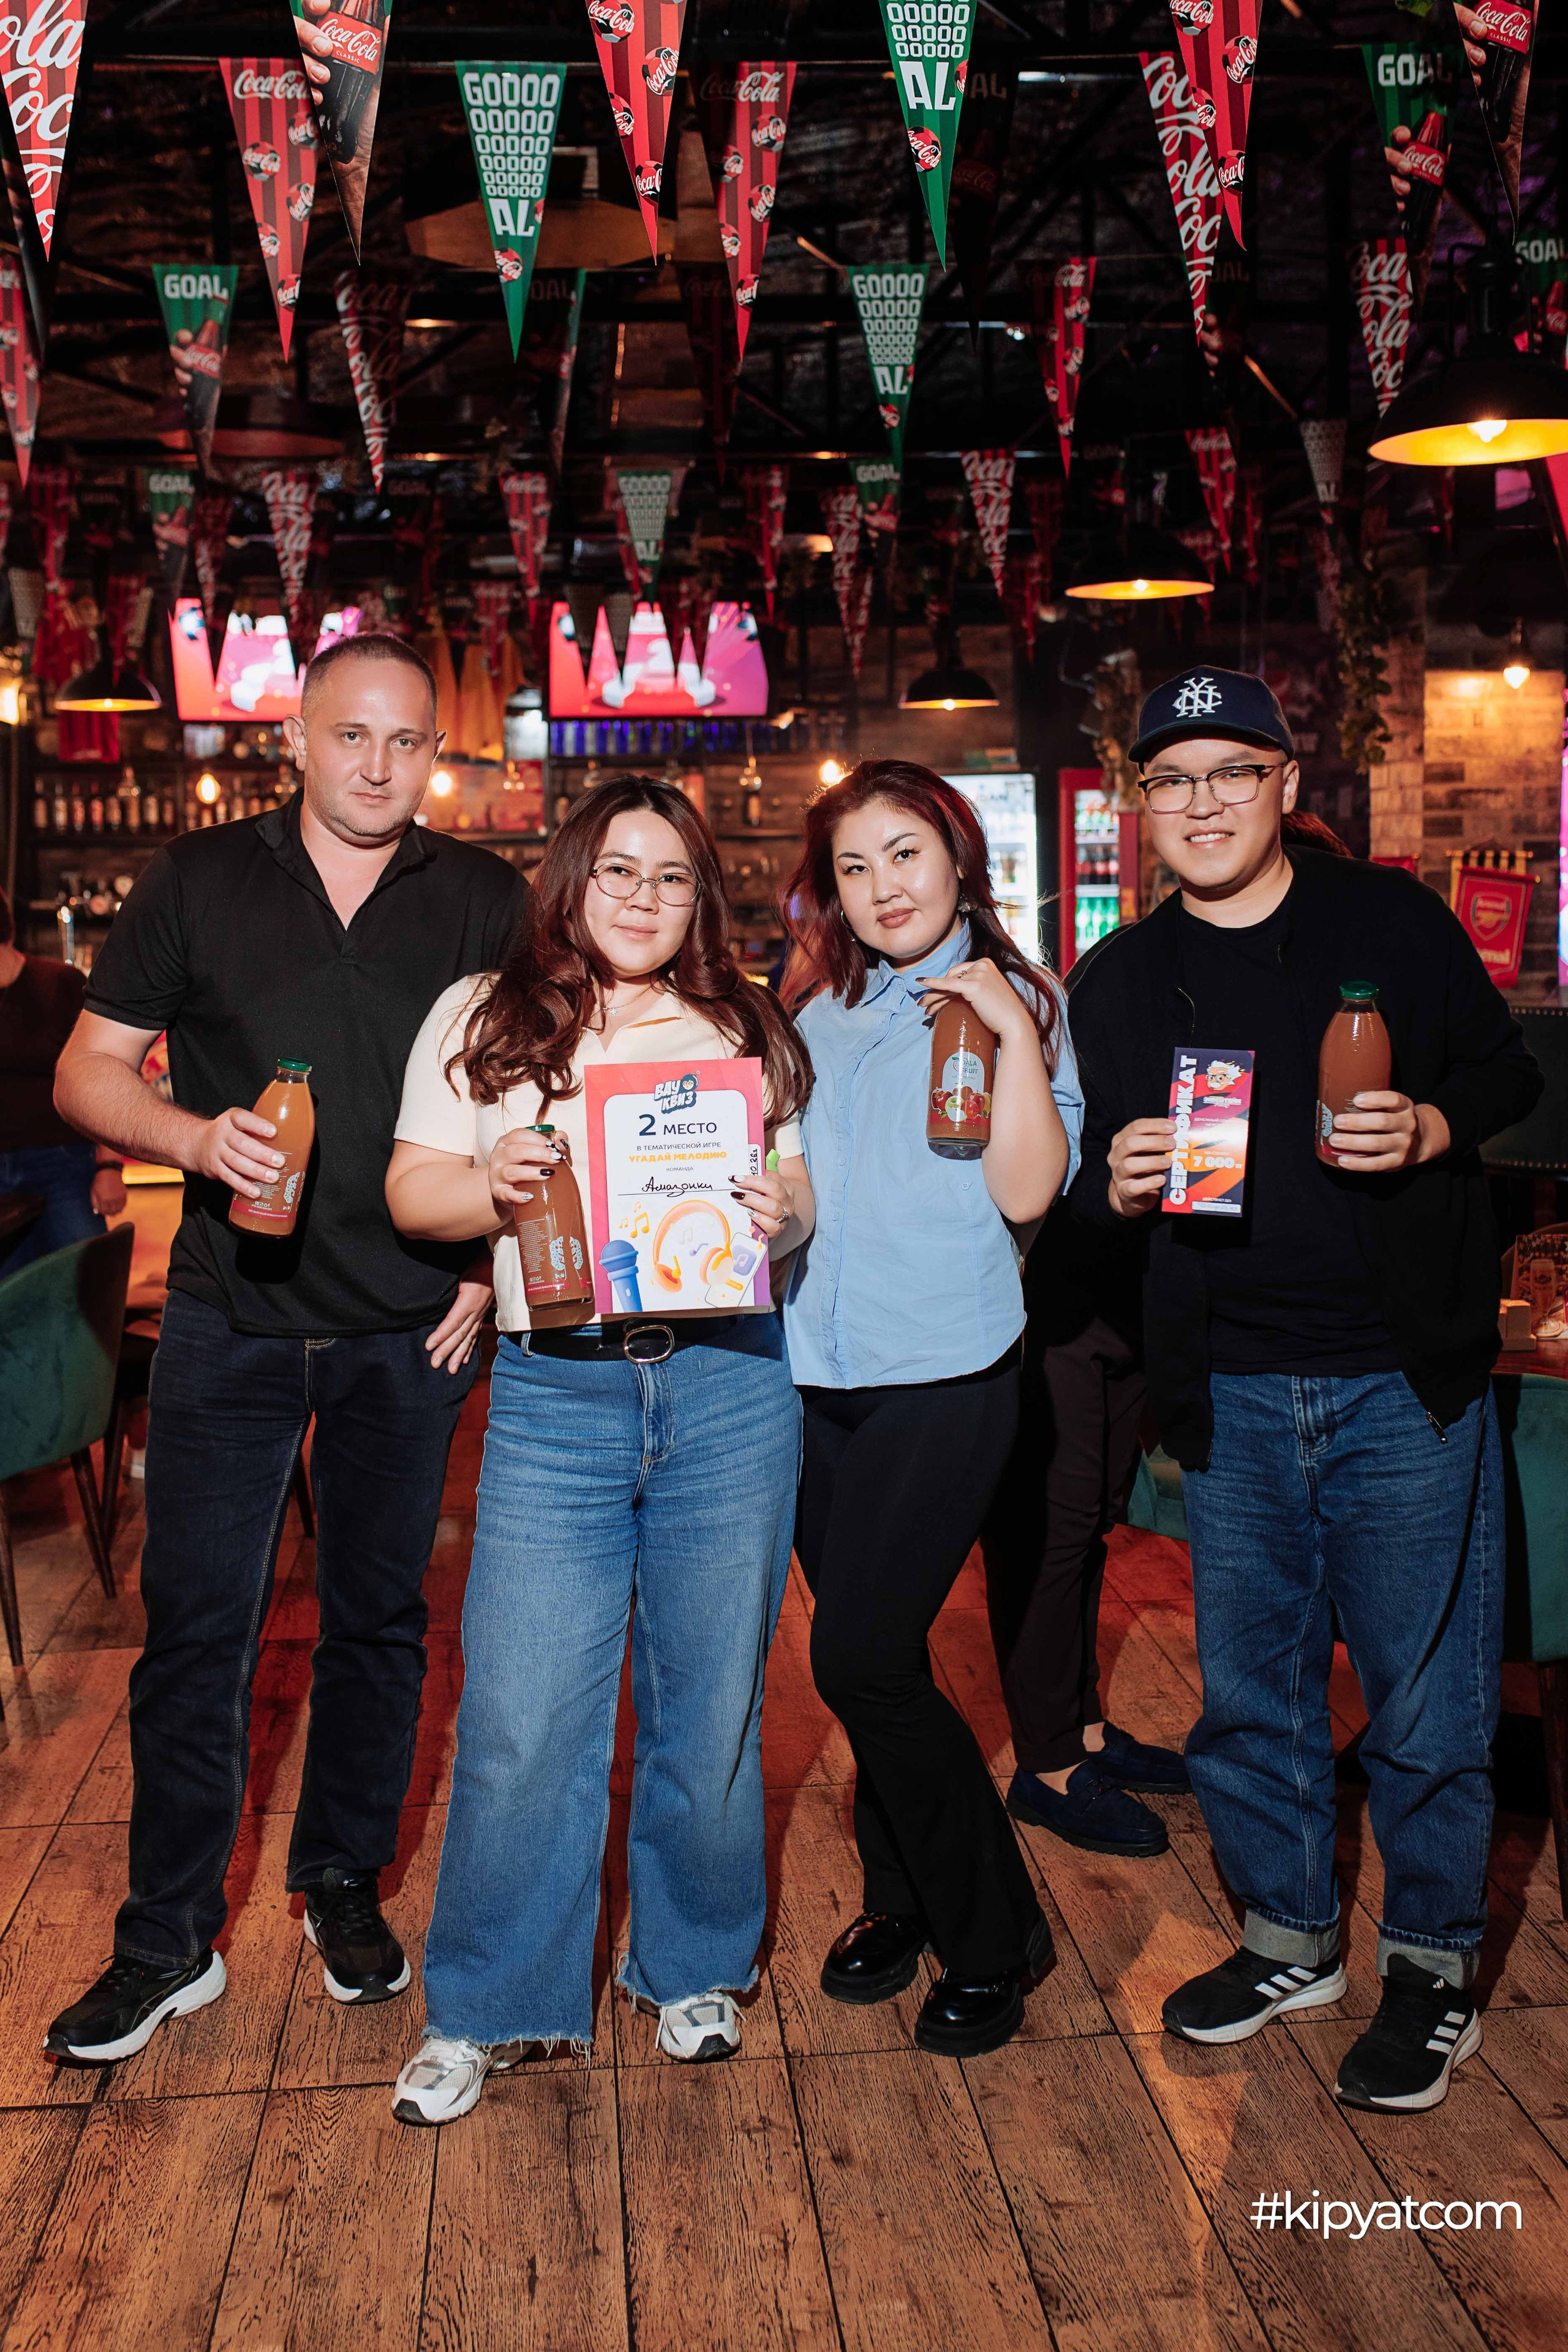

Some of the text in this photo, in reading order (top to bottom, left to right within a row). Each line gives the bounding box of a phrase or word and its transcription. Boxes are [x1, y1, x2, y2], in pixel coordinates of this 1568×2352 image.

[1490, 32, 1512, 43] CLASSIC
[336, 50, 360, 63] CLASSIC
[899, 61, 956, 110] AL
[488, 198, 535, 237] AL
[164, 273, 229, 300] GOAL
[873, 366, 908, 394] AL
[655, 1079, 681, 1101] ВАУ
[662, 1091, 695, 1112] КВИЗ
[639, 1114, 717, 1136] 2 МЕСТО
[644, 1142, 701, 1151] ТЕМАТИЧЕСКОЙ
[629, 1152, 727, 1163] УГАДАЙ МЕЛОДИЮ
[1194, 1156, 1203, 1167] 7
[1205, 1156, 1235, 1169] 000
[642, 1176, 713, 1197] Амазонки
